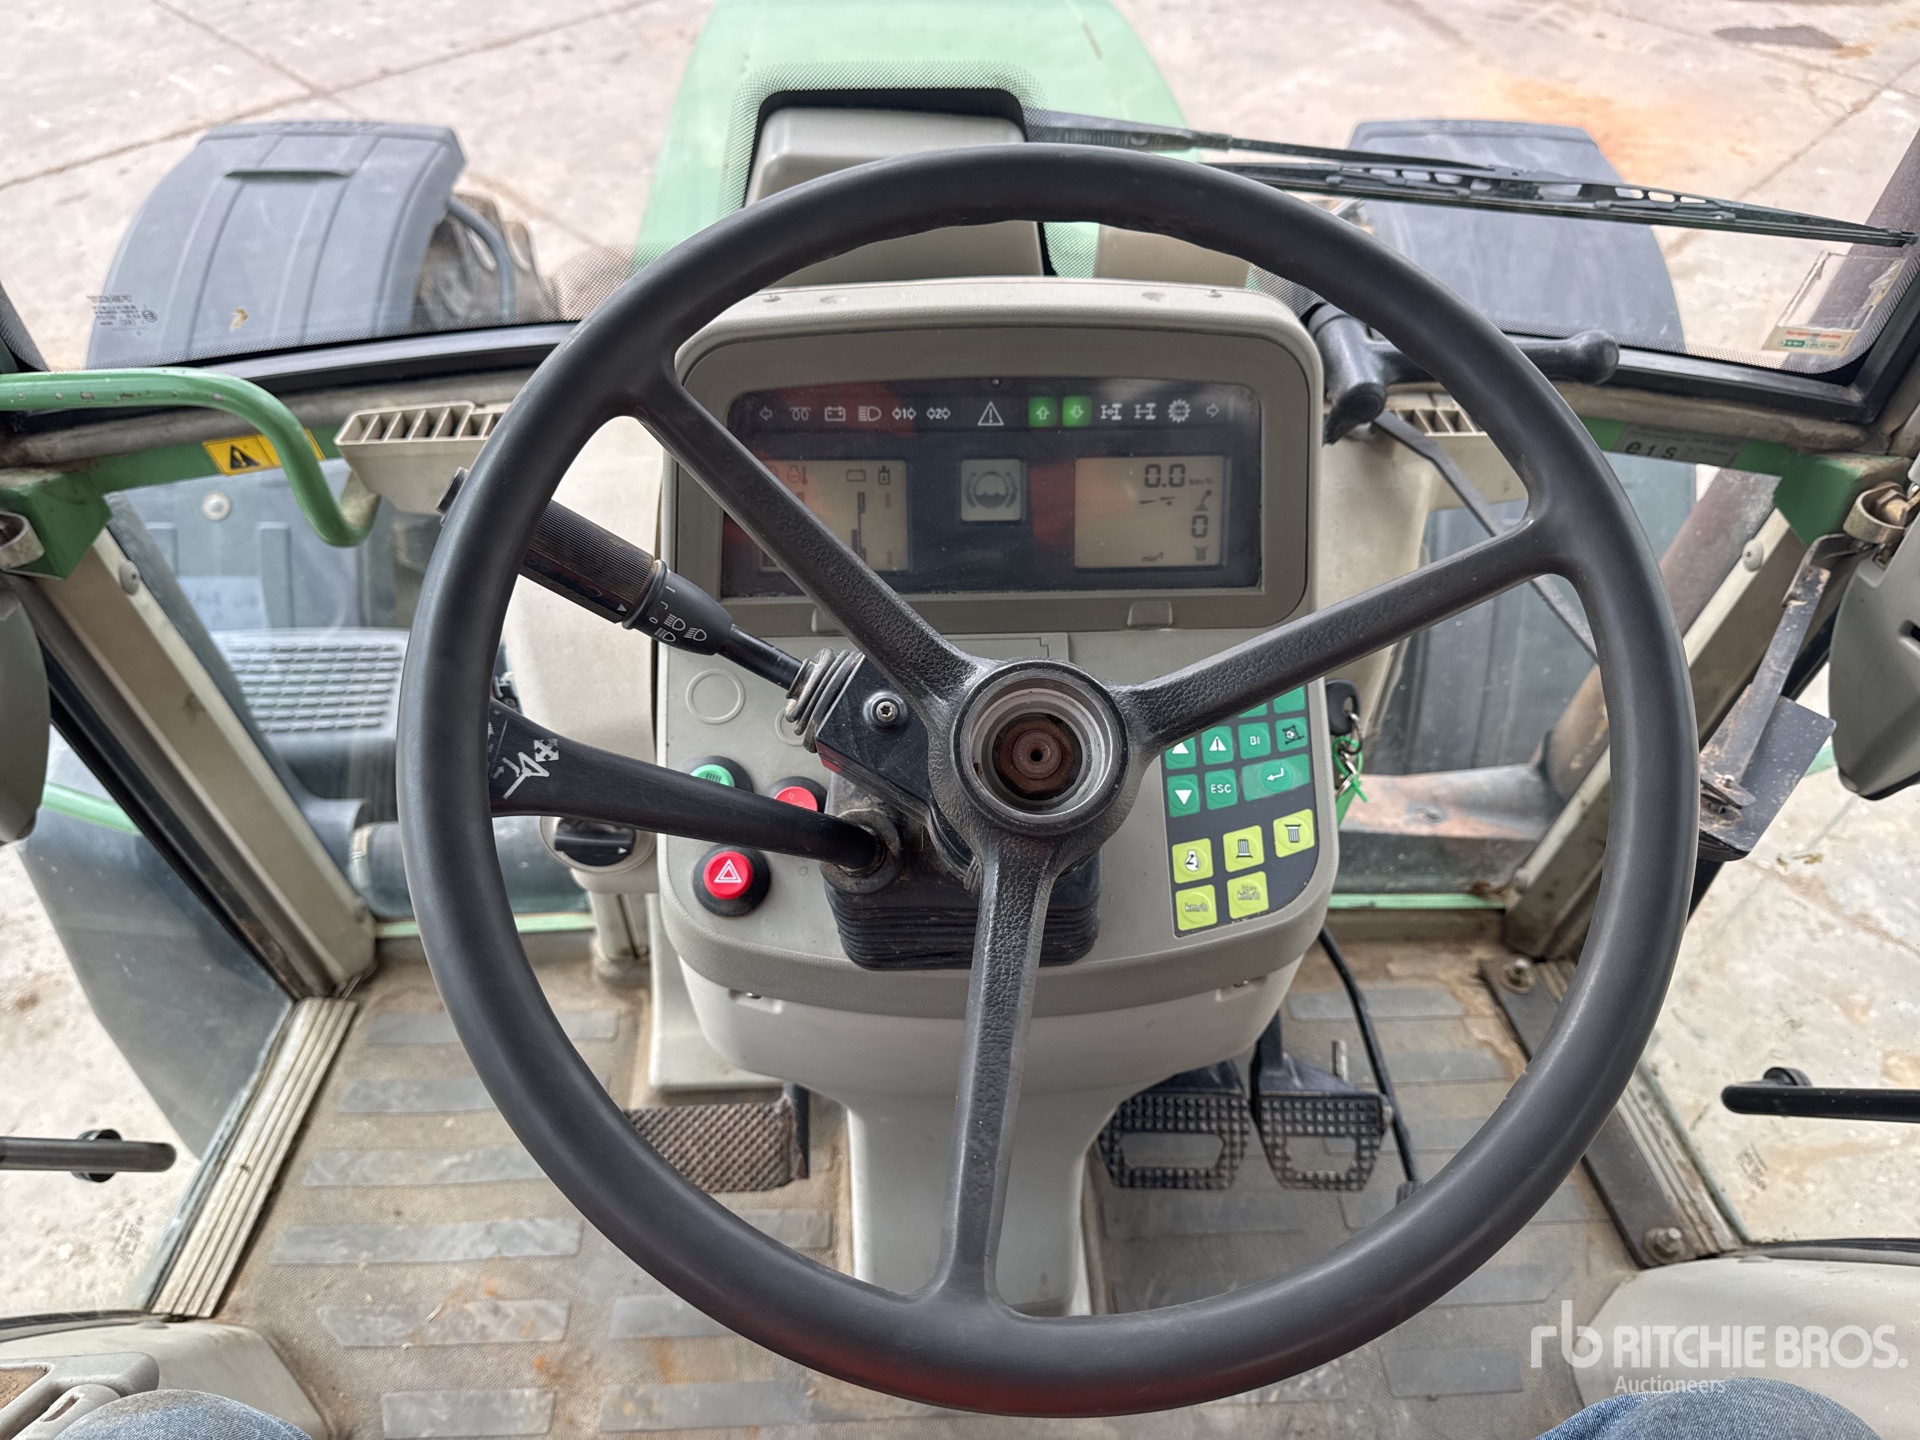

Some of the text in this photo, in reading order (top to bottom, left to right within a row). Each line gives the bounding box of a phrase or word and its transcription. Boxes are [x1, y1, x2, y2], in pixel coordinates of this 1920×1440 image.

[1144, 464, 1213, 488] 0.0 km/h
[1191, 514, 1208, 538] 0
[1210, 784, 1232, 794] ESC
